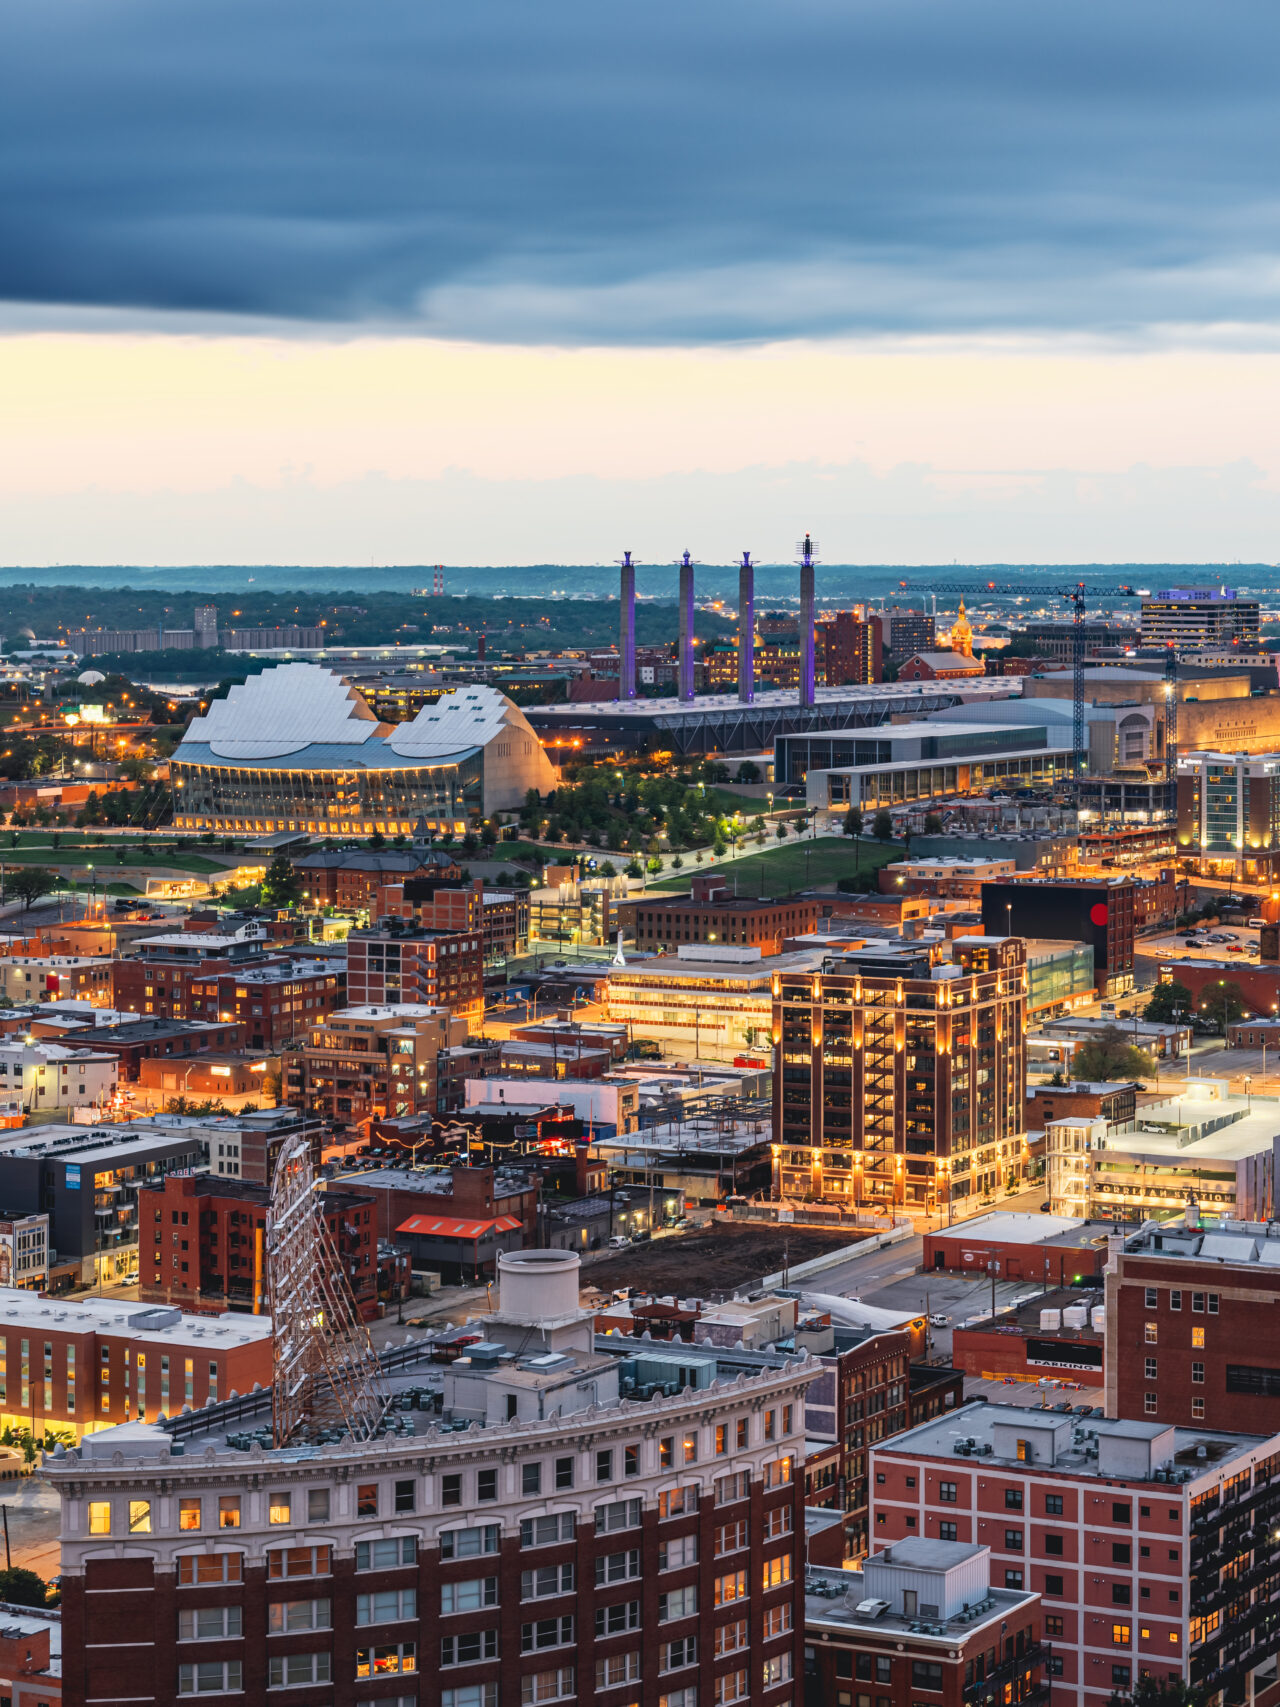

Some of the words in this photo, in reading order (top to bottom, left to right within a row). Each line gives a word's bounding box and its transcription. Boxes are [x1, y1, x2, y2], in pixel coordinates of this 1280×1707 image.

[1093, 1184, 1167, 1197] CORRIGAN
[1174, 1191, 1232, 1203] STATION
[1034, 1360, 1094, 1370] PARKING
